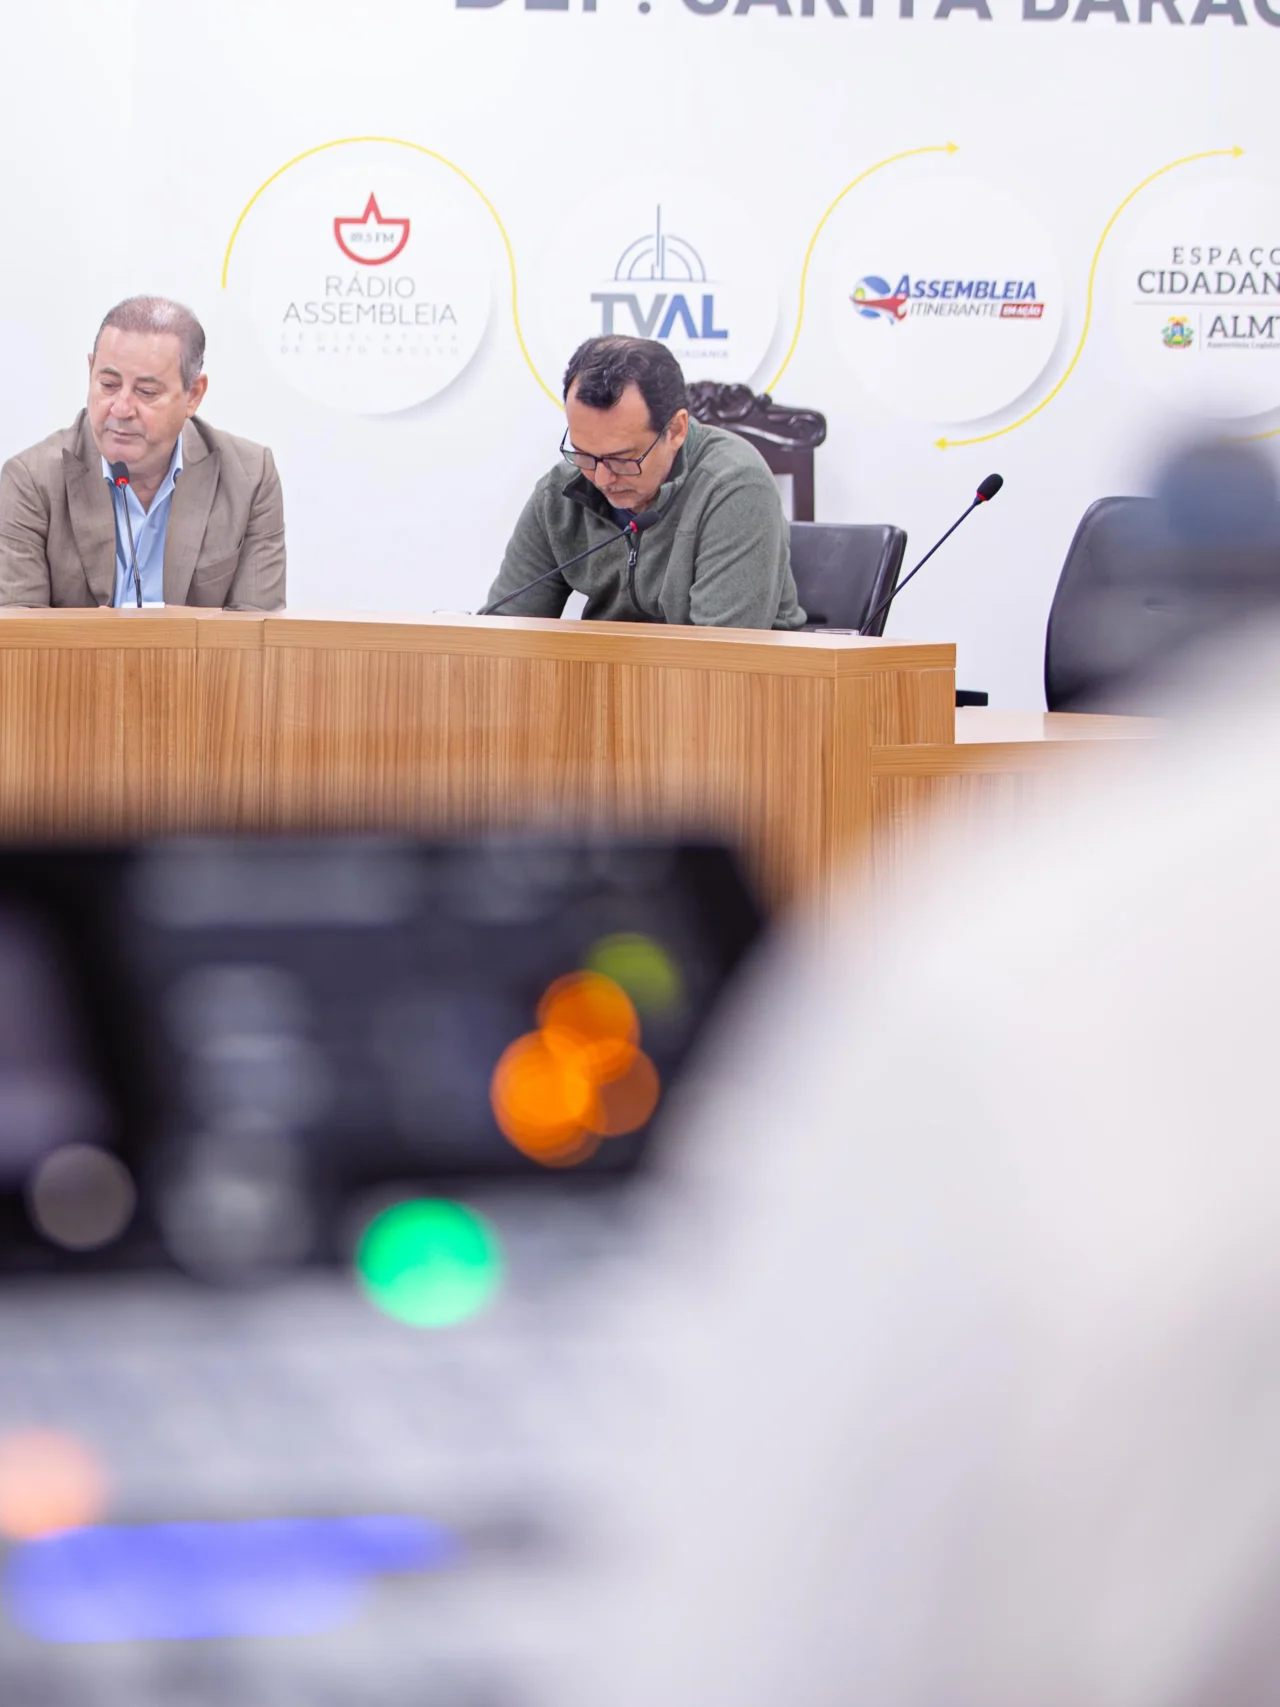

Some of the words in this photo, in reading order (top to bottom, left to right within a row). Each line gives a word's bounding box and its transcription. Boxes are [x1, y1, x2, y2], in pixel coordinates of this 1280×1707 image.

[325, 271, 416, 299] RÁDIO
[892, 274, 1037, 300] ASSEMBLEIA
[282, 301, 458, 325] ASSEMBLEIA
[590, 293, 728, 339] TVAL
[910, 302, 998, 317] ITINERANTE
